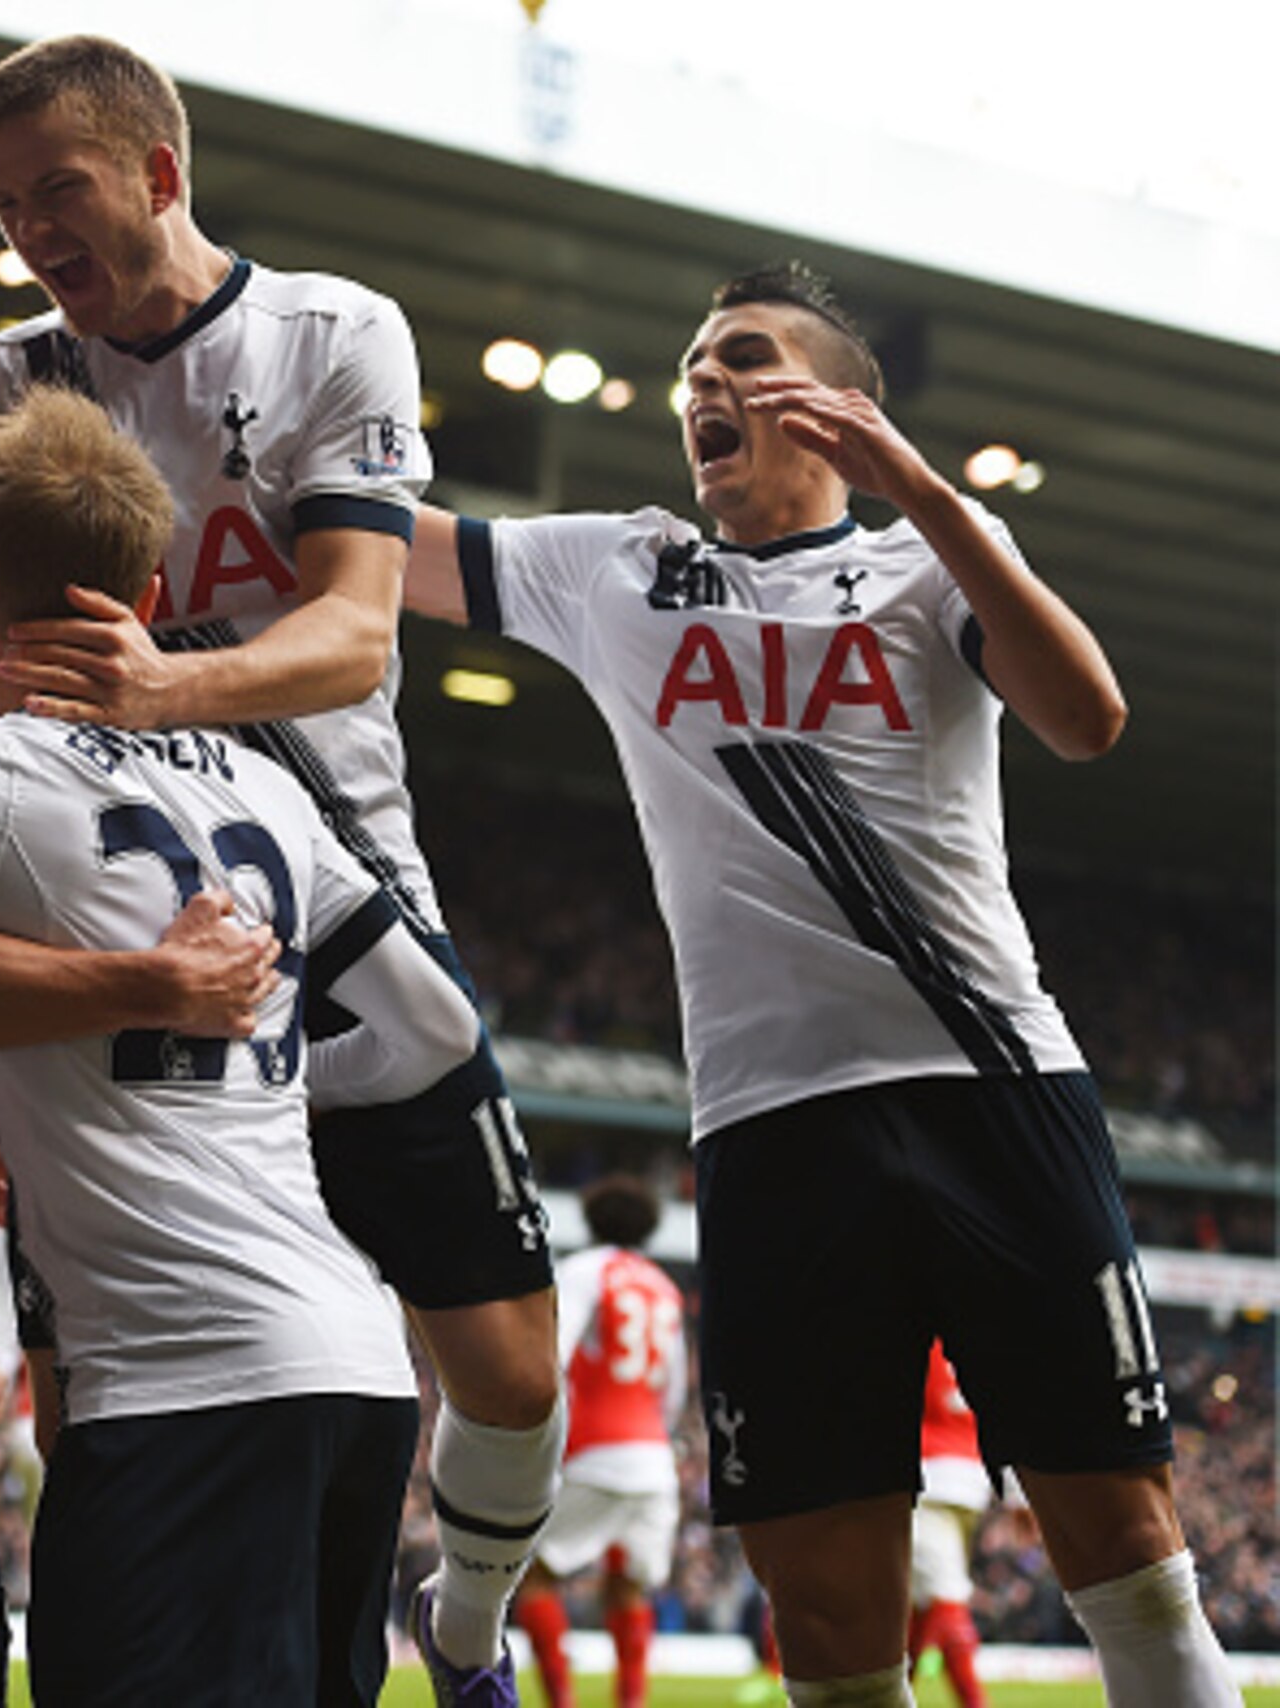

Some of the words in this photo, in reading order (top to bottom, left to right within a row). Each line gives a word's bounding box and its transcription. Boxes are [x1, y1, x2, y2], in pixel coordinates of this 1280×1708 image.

[656, 622, 913, 732] AIA
[610, 1290, 682, 1388] 35
[1094, 1259, 1160, 1379] 11
